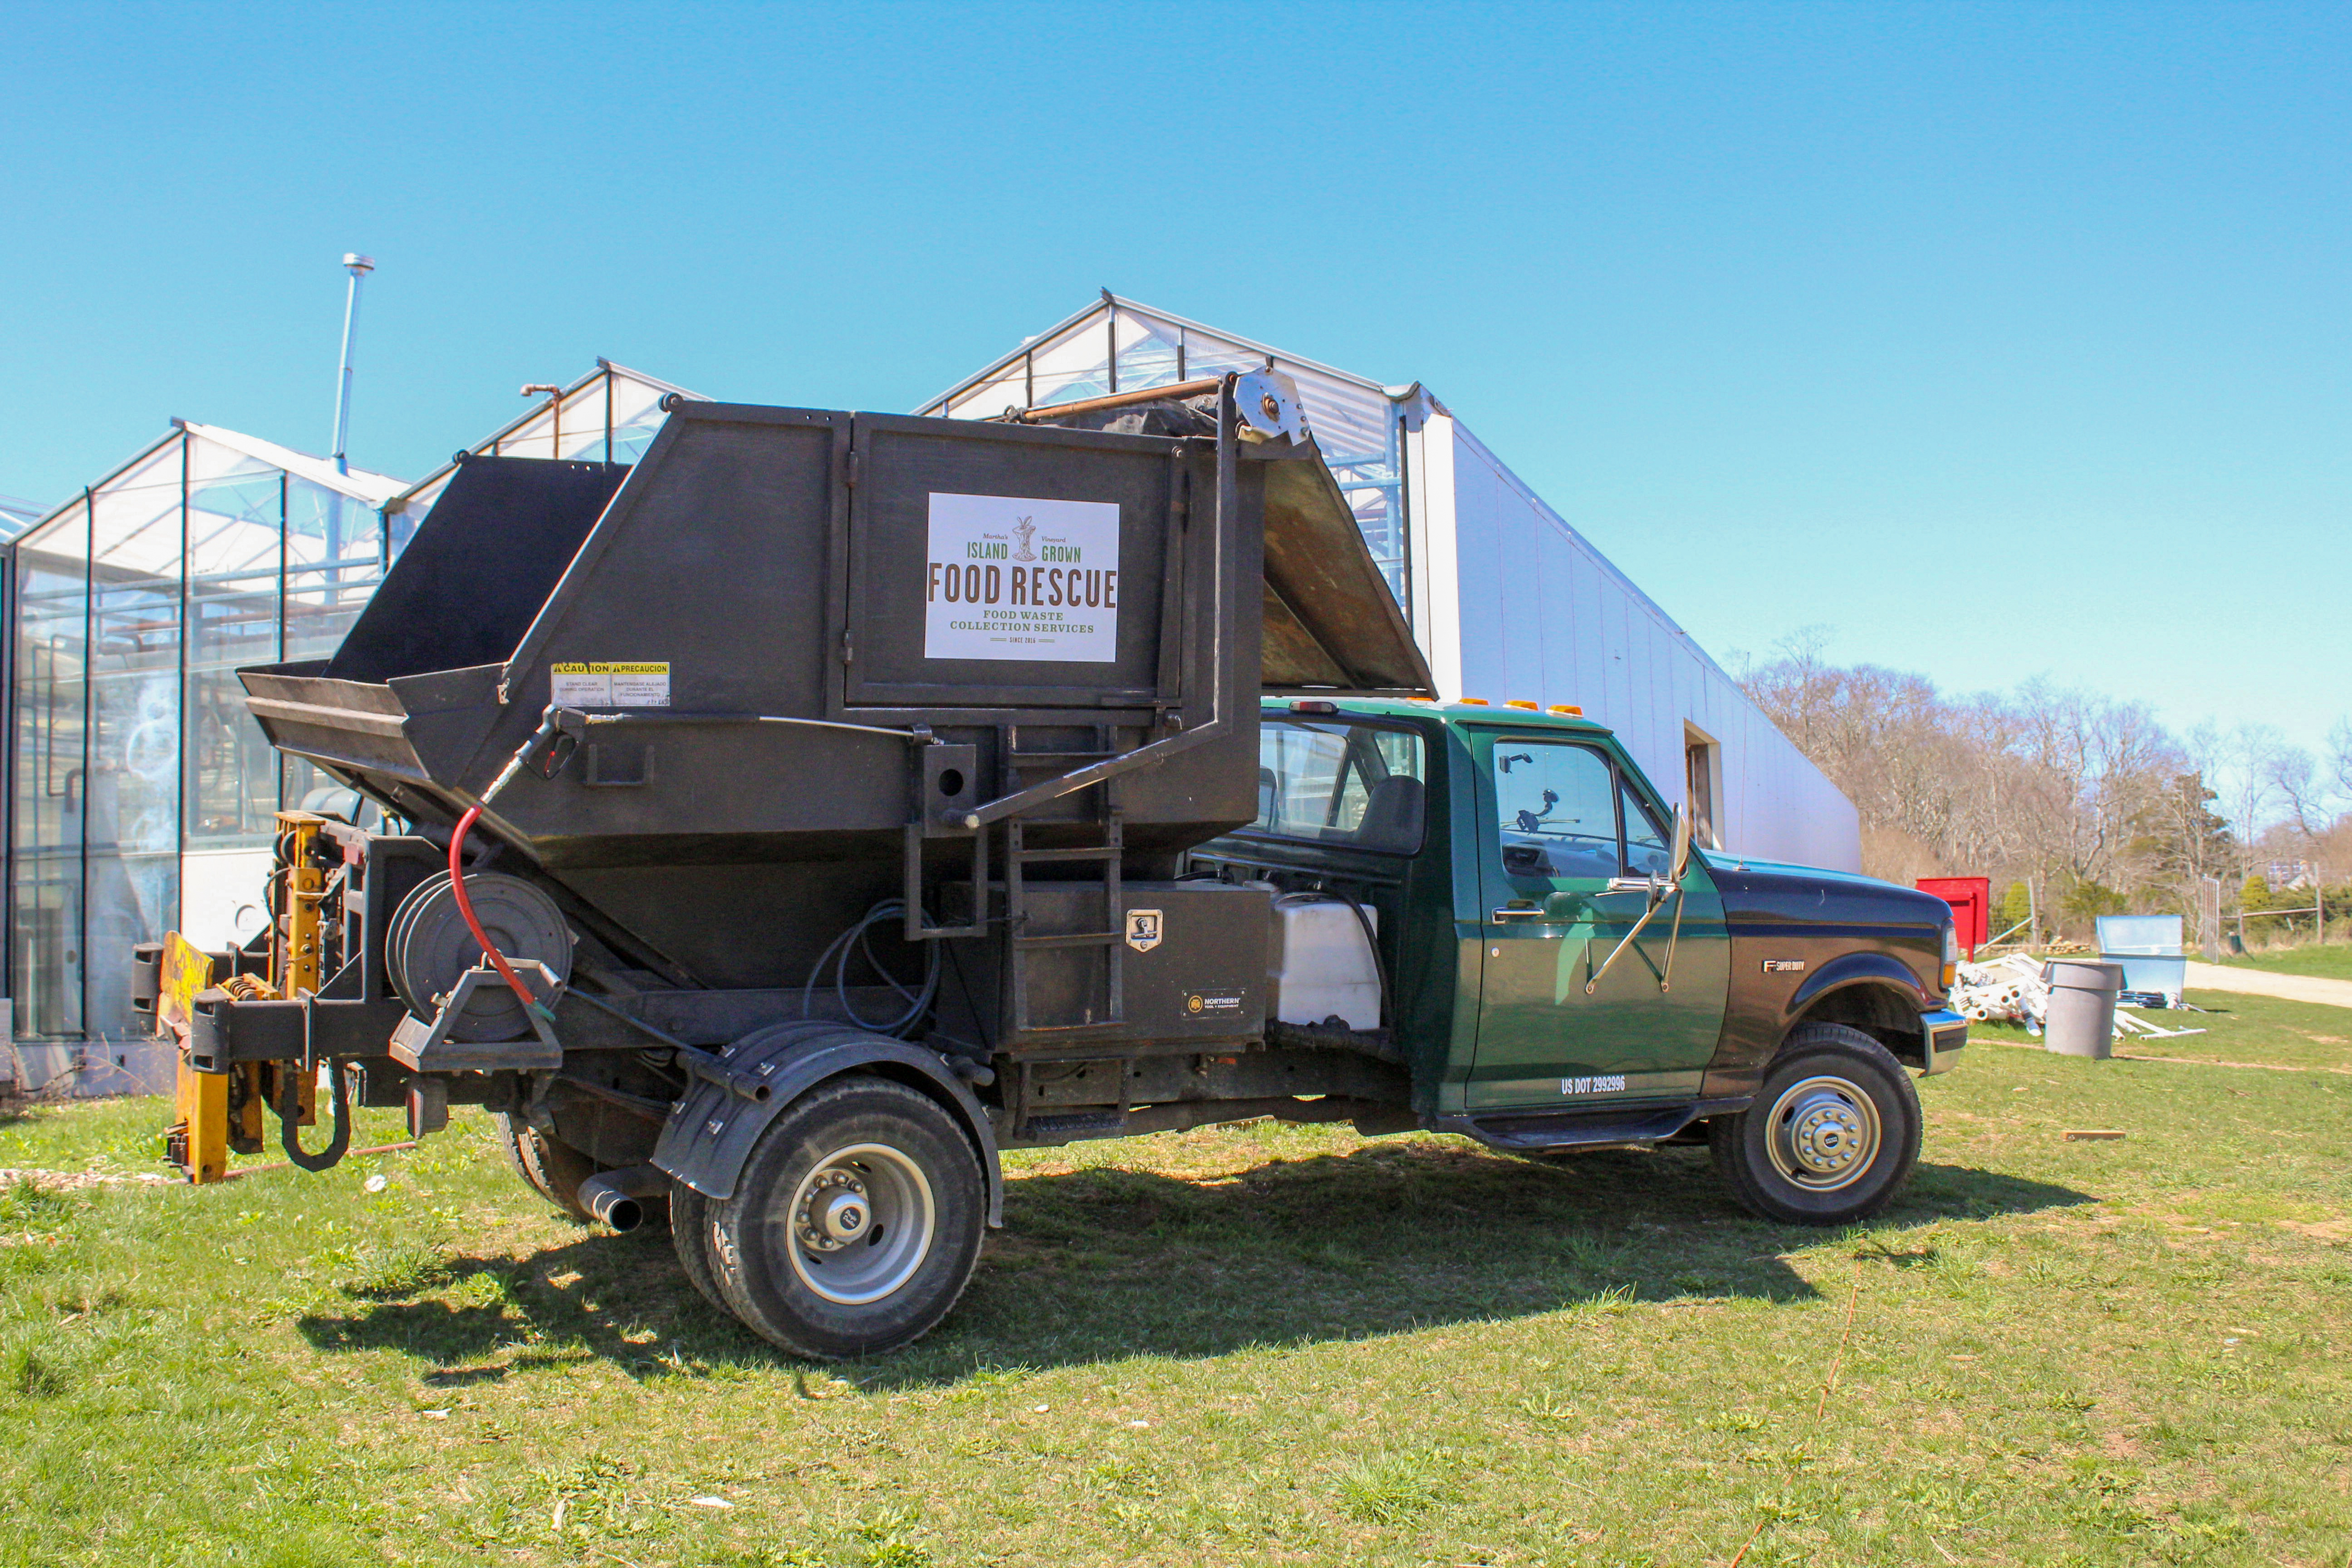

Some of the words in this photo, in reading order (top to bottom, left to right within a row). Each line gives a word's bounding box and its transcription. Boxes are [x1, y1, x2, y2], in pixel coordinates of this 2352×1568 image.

[967, 541, 1008, 559] ISLAND
[1042, 545, 1081, 563] GROWN
[928, 562, 1000, 604] FOOD
[1011, 566, 1117, 608] RESCUE
[983, 610, 1017, 619] FOOD
[1020, 611, 1064, 621] WASTE
[950, 621, 1031, 631] COLLECTION
[1034, 624, 1094, 633] SERVICES
[1776, 961, 1792, 971] SUPER
[1792, 961, 1805, 971] DUTY
[1561, 1078, 1573, 1095] US
[1575, 1077, 1592, 1094] DOT
[1592, 1075, 1625, 1093] 2992996
